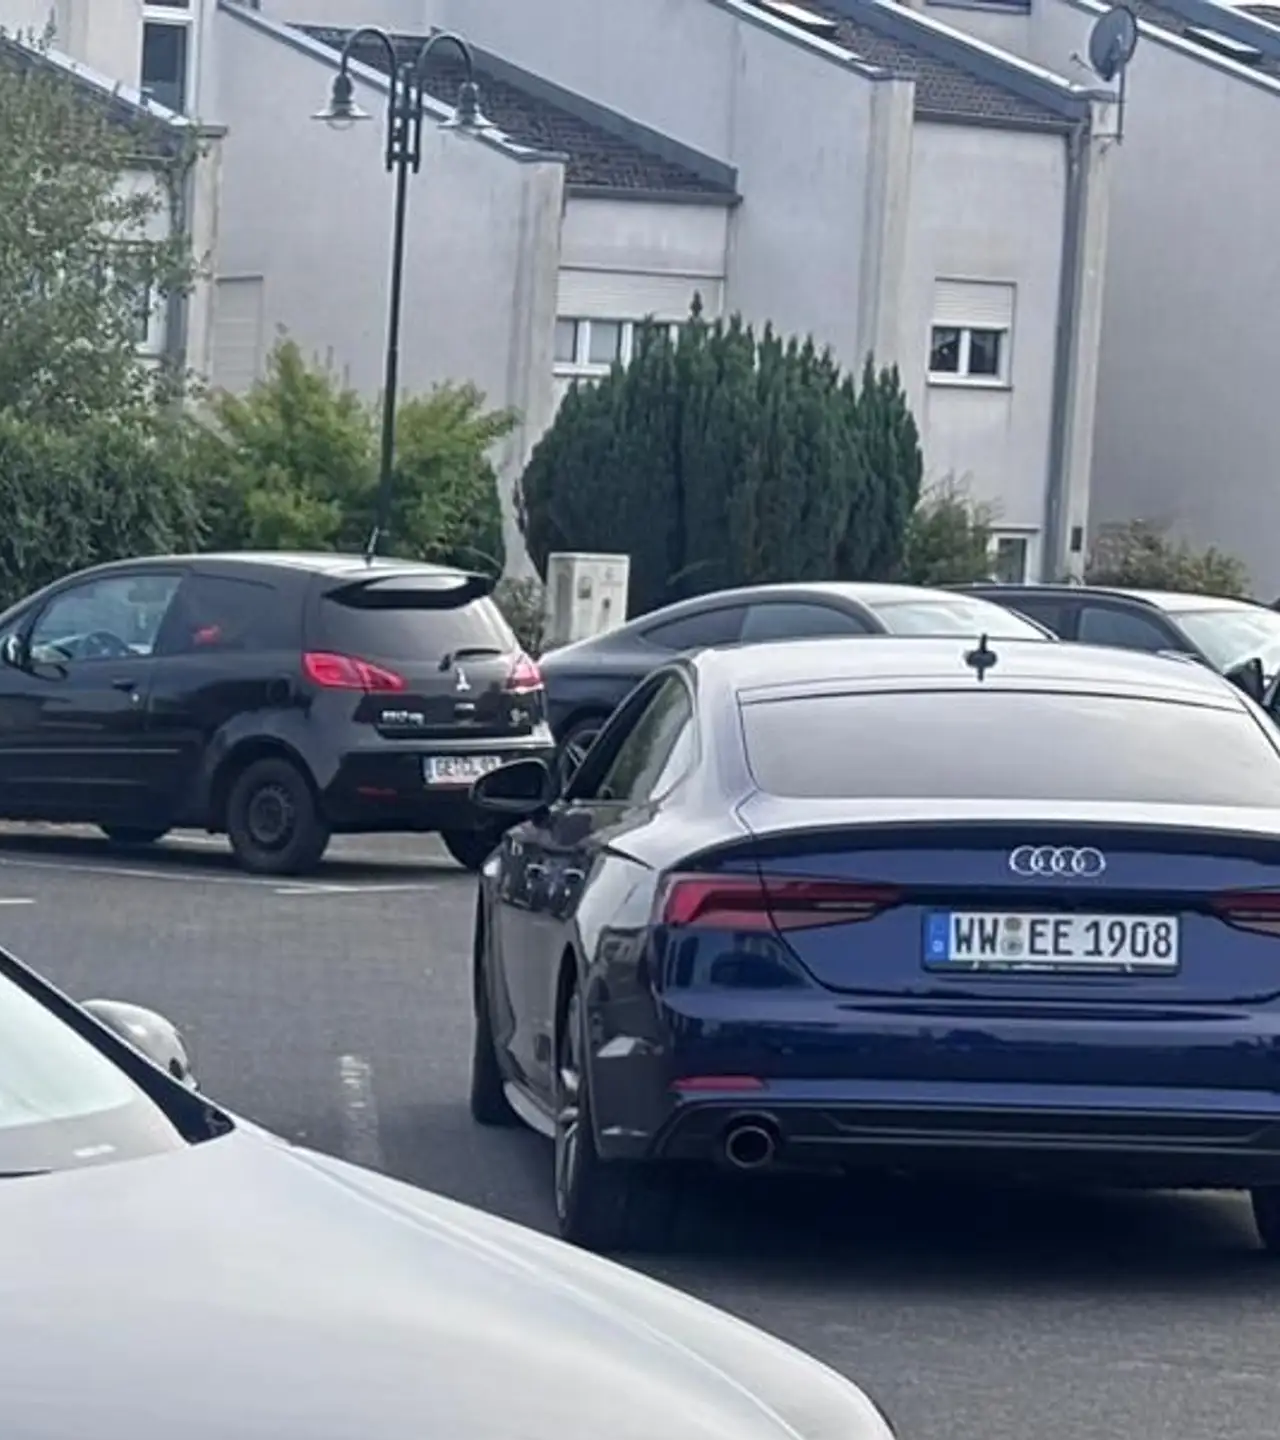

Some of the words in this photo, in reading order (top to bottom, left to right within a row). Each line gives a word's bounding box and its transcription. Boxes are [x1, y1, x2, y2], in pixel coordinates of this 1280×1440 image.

[955, 917, 999, 955] WW
[1029, 919, 1073, 956] EE
[1084, 920, 1173, 959] 1908
